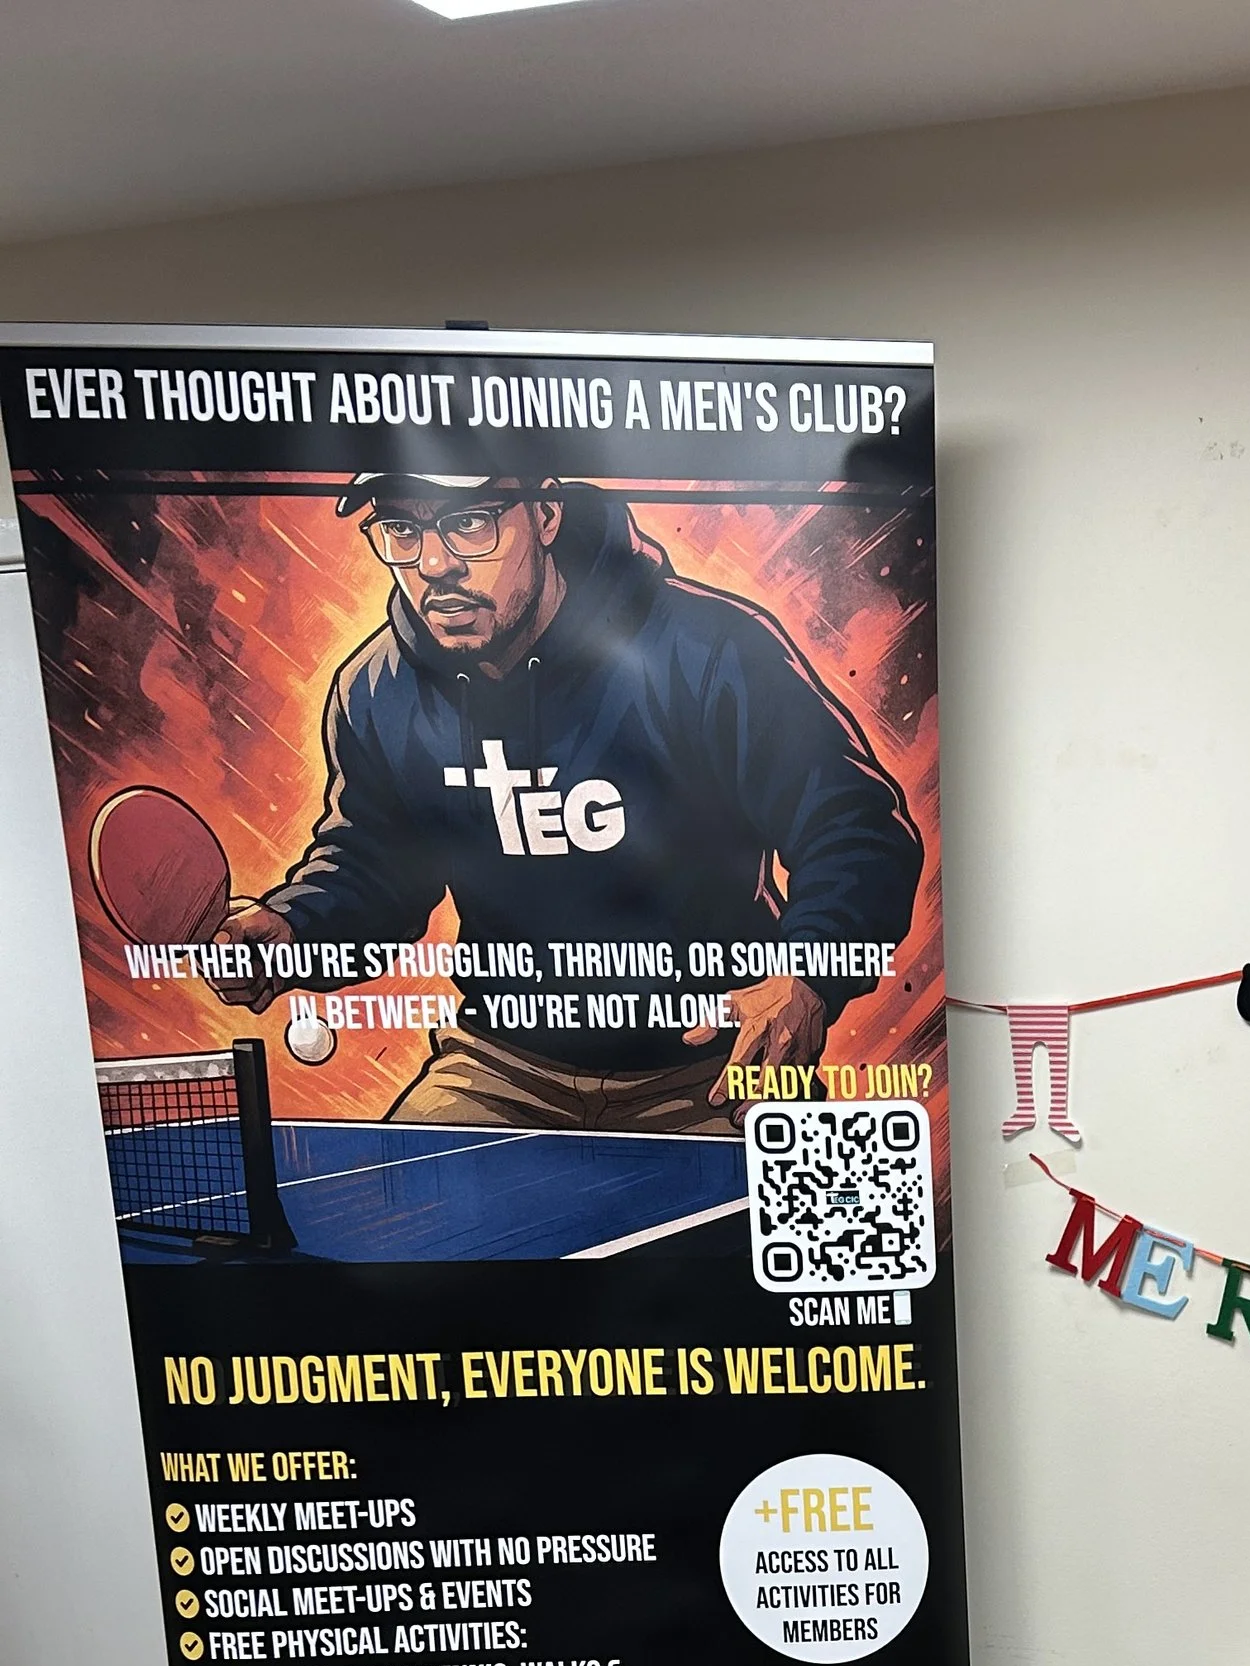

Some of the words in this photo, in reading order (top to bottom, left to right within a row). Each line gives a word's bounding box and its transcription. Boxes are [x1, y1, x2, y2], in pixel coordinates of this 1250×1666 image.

[25, 368, 127, 420] EVER
[133, 369, 317, 423] THOUGHT
[329, 372, 456, 426] ABOUT
[468, 376, 614, 430] JOINING
[625, 380, 650, 431] A
[660, 382, 779, 433] MEN'S
[789, 383, 908, 436] CLUB?
[124, 943, 254, 979] WHETHER
[260, 944, 359, 979] YOU'RE
[365, 943, 542, 979] STRUGGLING,
[548, 942, 682, 979] THRIVING,
[689, 942, 725, 977] OR
[731, 942, 896, 977] SOMEWHERE
[289, 996, 319, 1030] IN
[326, 996, 457, 1030] BETWEEN
[483, 995, 580, 1030] YOU'RE
[586, 995, 640, 1029] NOT
[647, 995, 741, 1029] ALONE.
[727, 1067, 813, 1100] READY
[822, 1066, 859, 1099] TO
[863, 1064, 933, 1098] JOIN?
[788, 1296, 851, 1327] SCAN
[856, 1295, 891, 1325] ME
[164, 1356, 216, 1406] NO
[228, 1352, 451, 1408] JUDGMENT,
[461, 1348, 667, 1399] EVERYONE
[677, 1347, 714, 1395] IS
[723, 1343, 926, 1395] WELCOME.
[160, 1451, 221, 1483] WHAT
[226, 1452, 267, 1482] WE
[271, 1450, 357, 1482] OFFER:
[194, 1502, 288, 1533] WEEKLY
[293, 1498, 417, 1531] MEET-UPS
[754, 1486, 873, 1533] +FREE
[200, 1546, 262, 1576] OPEN
[266, 1540, 425, 1575] DISCUSSIONS
[428, 1537, 492, 1568] WITH
[497, 1536, 531, 1566] NO
[536, 1533, 657, 1564] PRESSURE
[755, 1549, 829, 1574] ACCESS
[833, 1548, 859, 1572] TO
[864, 1546, 900, 1571] ALL
[204, 1588, 289, 1618] SOCIAL
[292, 1583, 414, 1616] MEET-UPS
[418, 1582, 436, 1611] &
[441, 1578, 532, 1610] EVENTS
[756, 1583, 860, 1609] ACTIVITIES
[864, 1581, 901, 1606] FOR
[208, 1631, 268, 1660] FREE
[271, 1626, 389, 1659] PHYSICAL
[394, 1620, 528, 1654] ACTIVITIES:
[782, 1617, 879, 1644] MEMBERS
